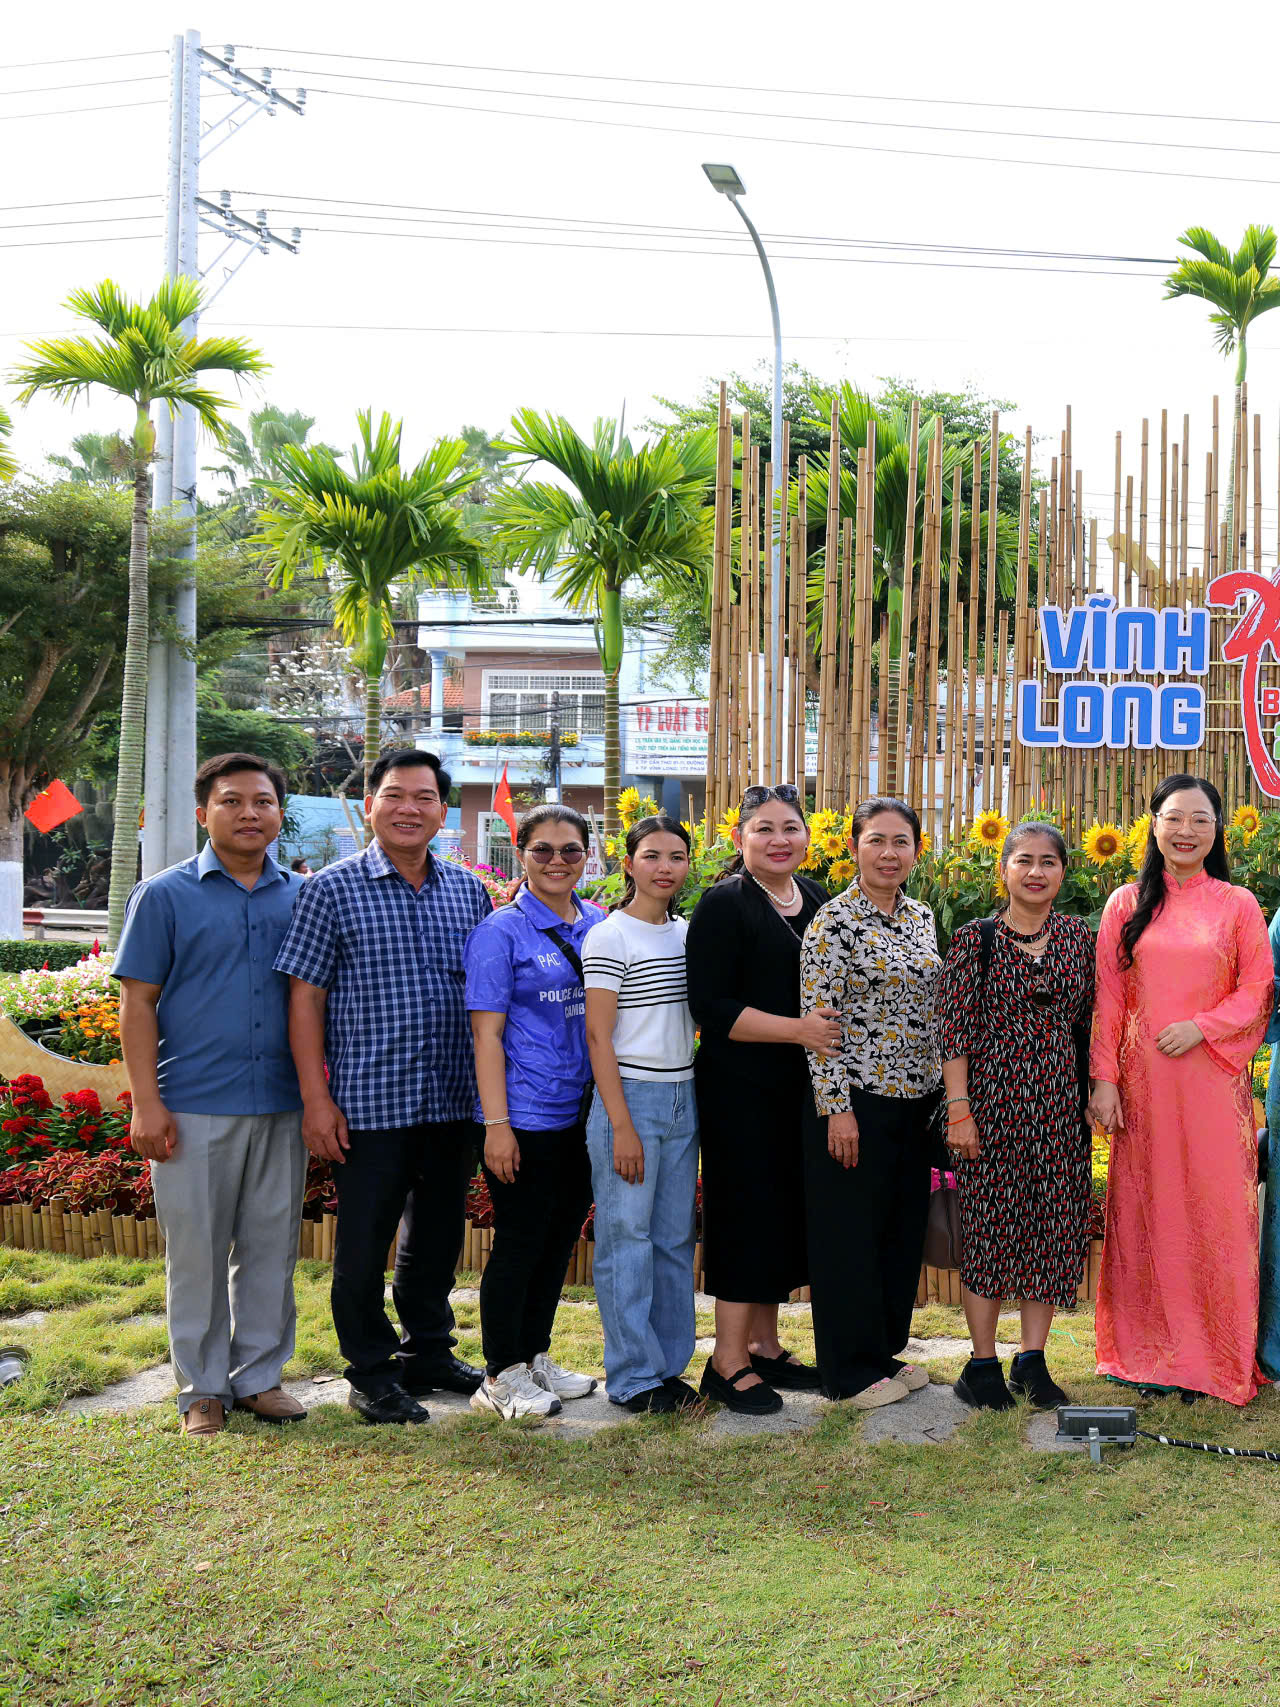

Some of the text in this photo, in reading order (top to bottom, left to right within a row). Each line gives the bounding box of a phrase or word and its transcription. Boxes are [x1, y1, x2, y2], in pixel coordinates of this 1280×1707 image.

[1041, 595, 1208, 673] VĨNH
[636, 706, 651, 731] VP
[1020, 683, 1204, 747] LONG
[537, 952, 561, 968] PAC
[539, 986, 585, 1002] POLICE AC
